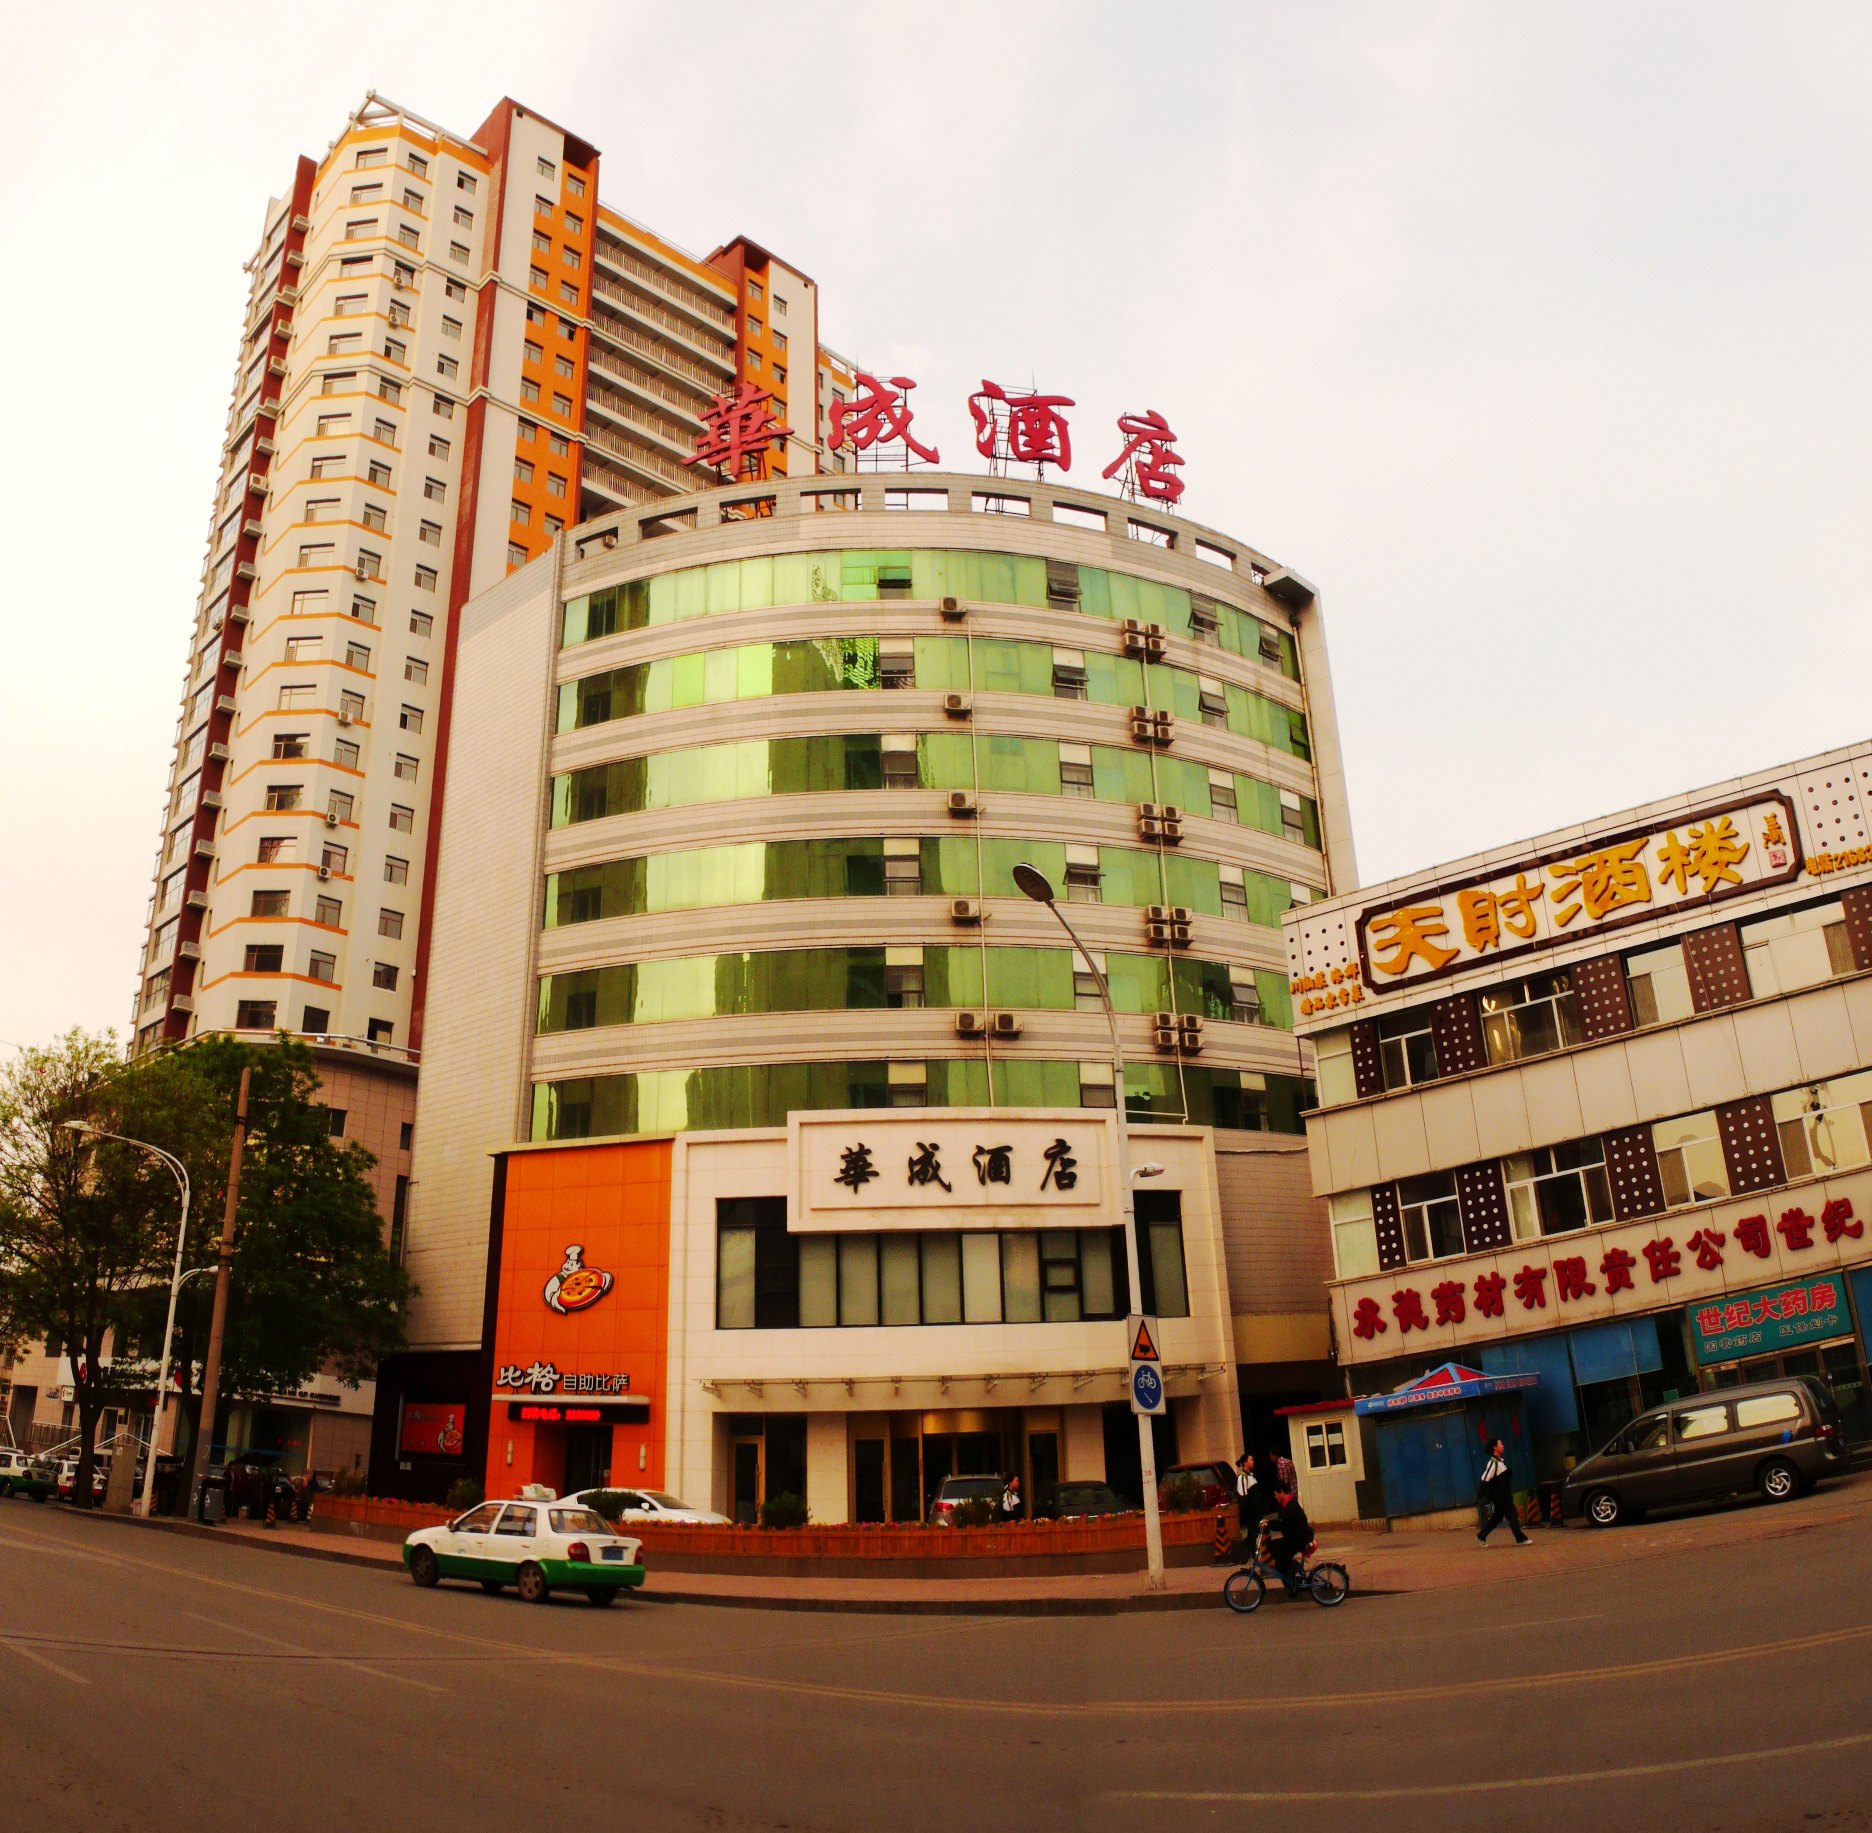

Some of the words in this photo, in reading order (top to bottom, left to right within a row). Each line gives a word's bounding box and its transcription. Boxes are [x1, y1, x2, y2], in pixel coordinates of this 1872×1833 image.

[834, 1138, 1079, 1195] 華成酒店
[1696, 1282, 1838, 1337] 世纪大药房
